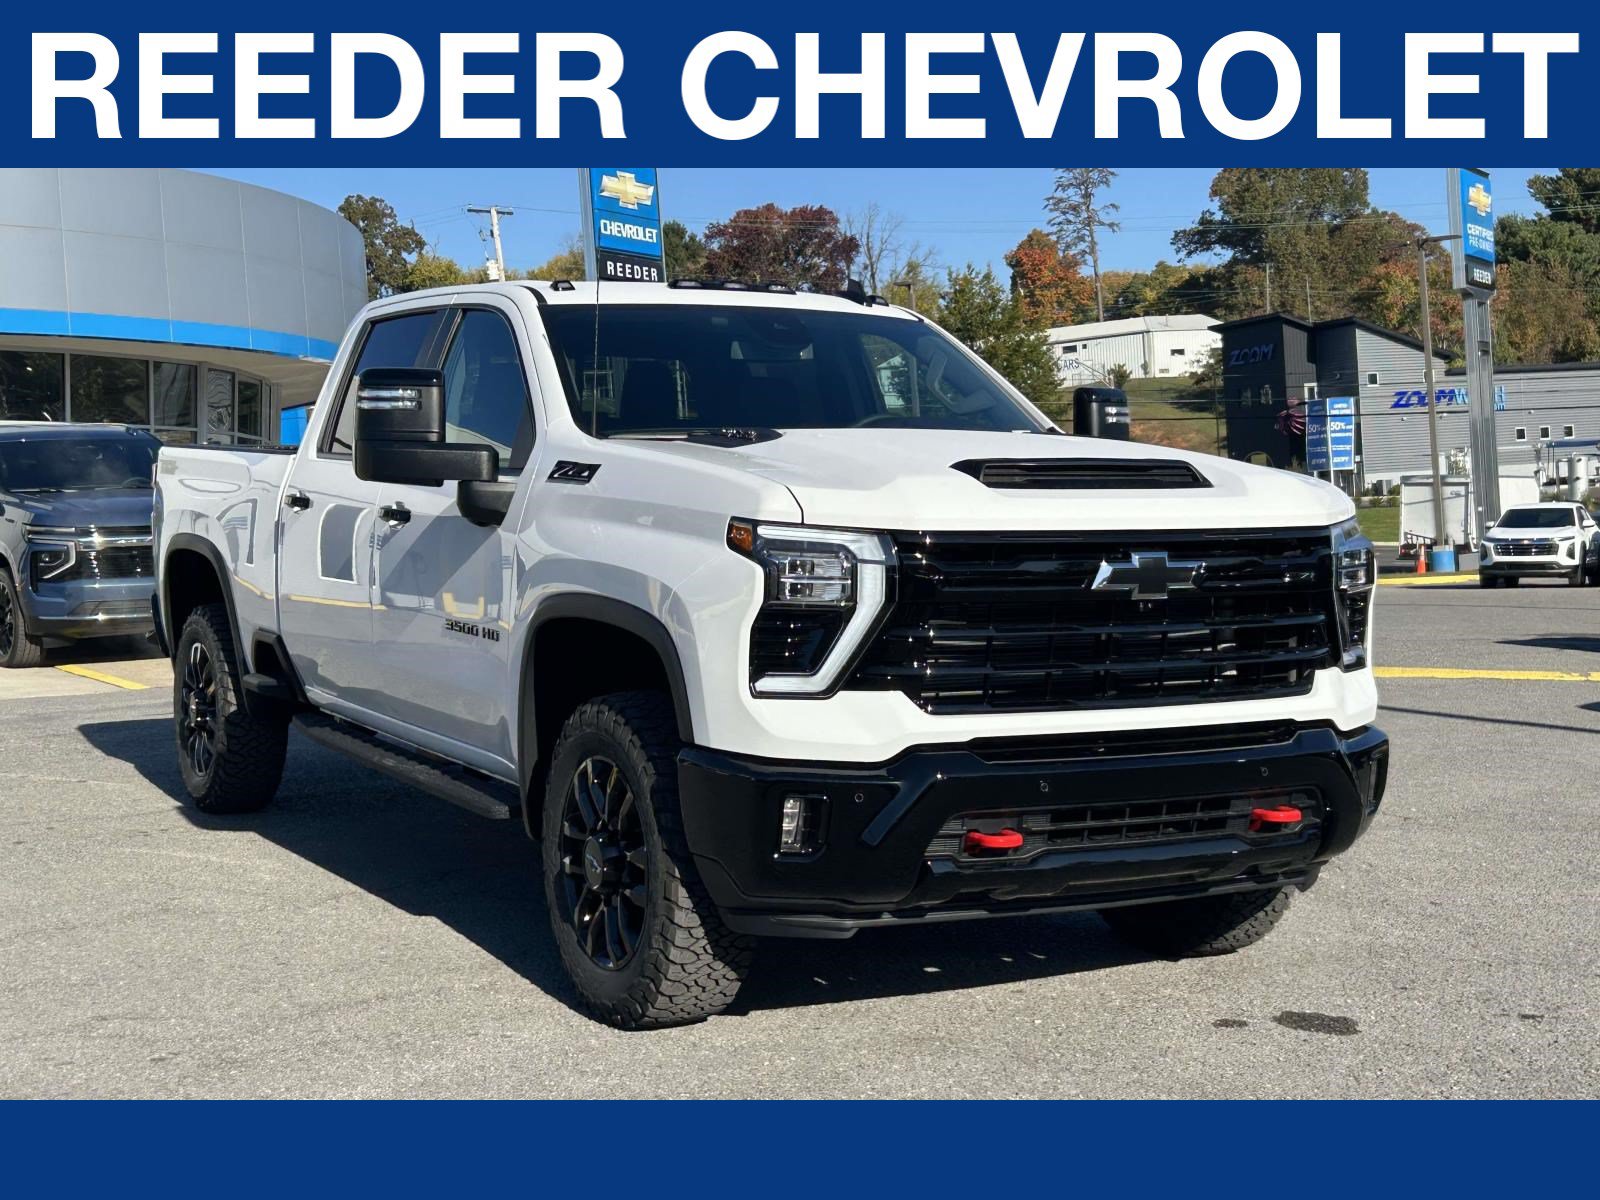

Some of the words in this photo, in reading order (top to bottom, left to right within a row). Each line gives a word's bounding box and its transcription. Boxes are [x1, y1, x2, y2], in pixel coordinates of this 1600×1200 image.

[600, 219, 658, 243] CHEVROLET
[606, 261, 658, 281] REEDER
[1473, 268, 1492, 285] REEDER
[1227, 343, 1275, 368] ZOOM
[445, 618, 479, 637] 3500
[482, 626, 500, 642] HD
